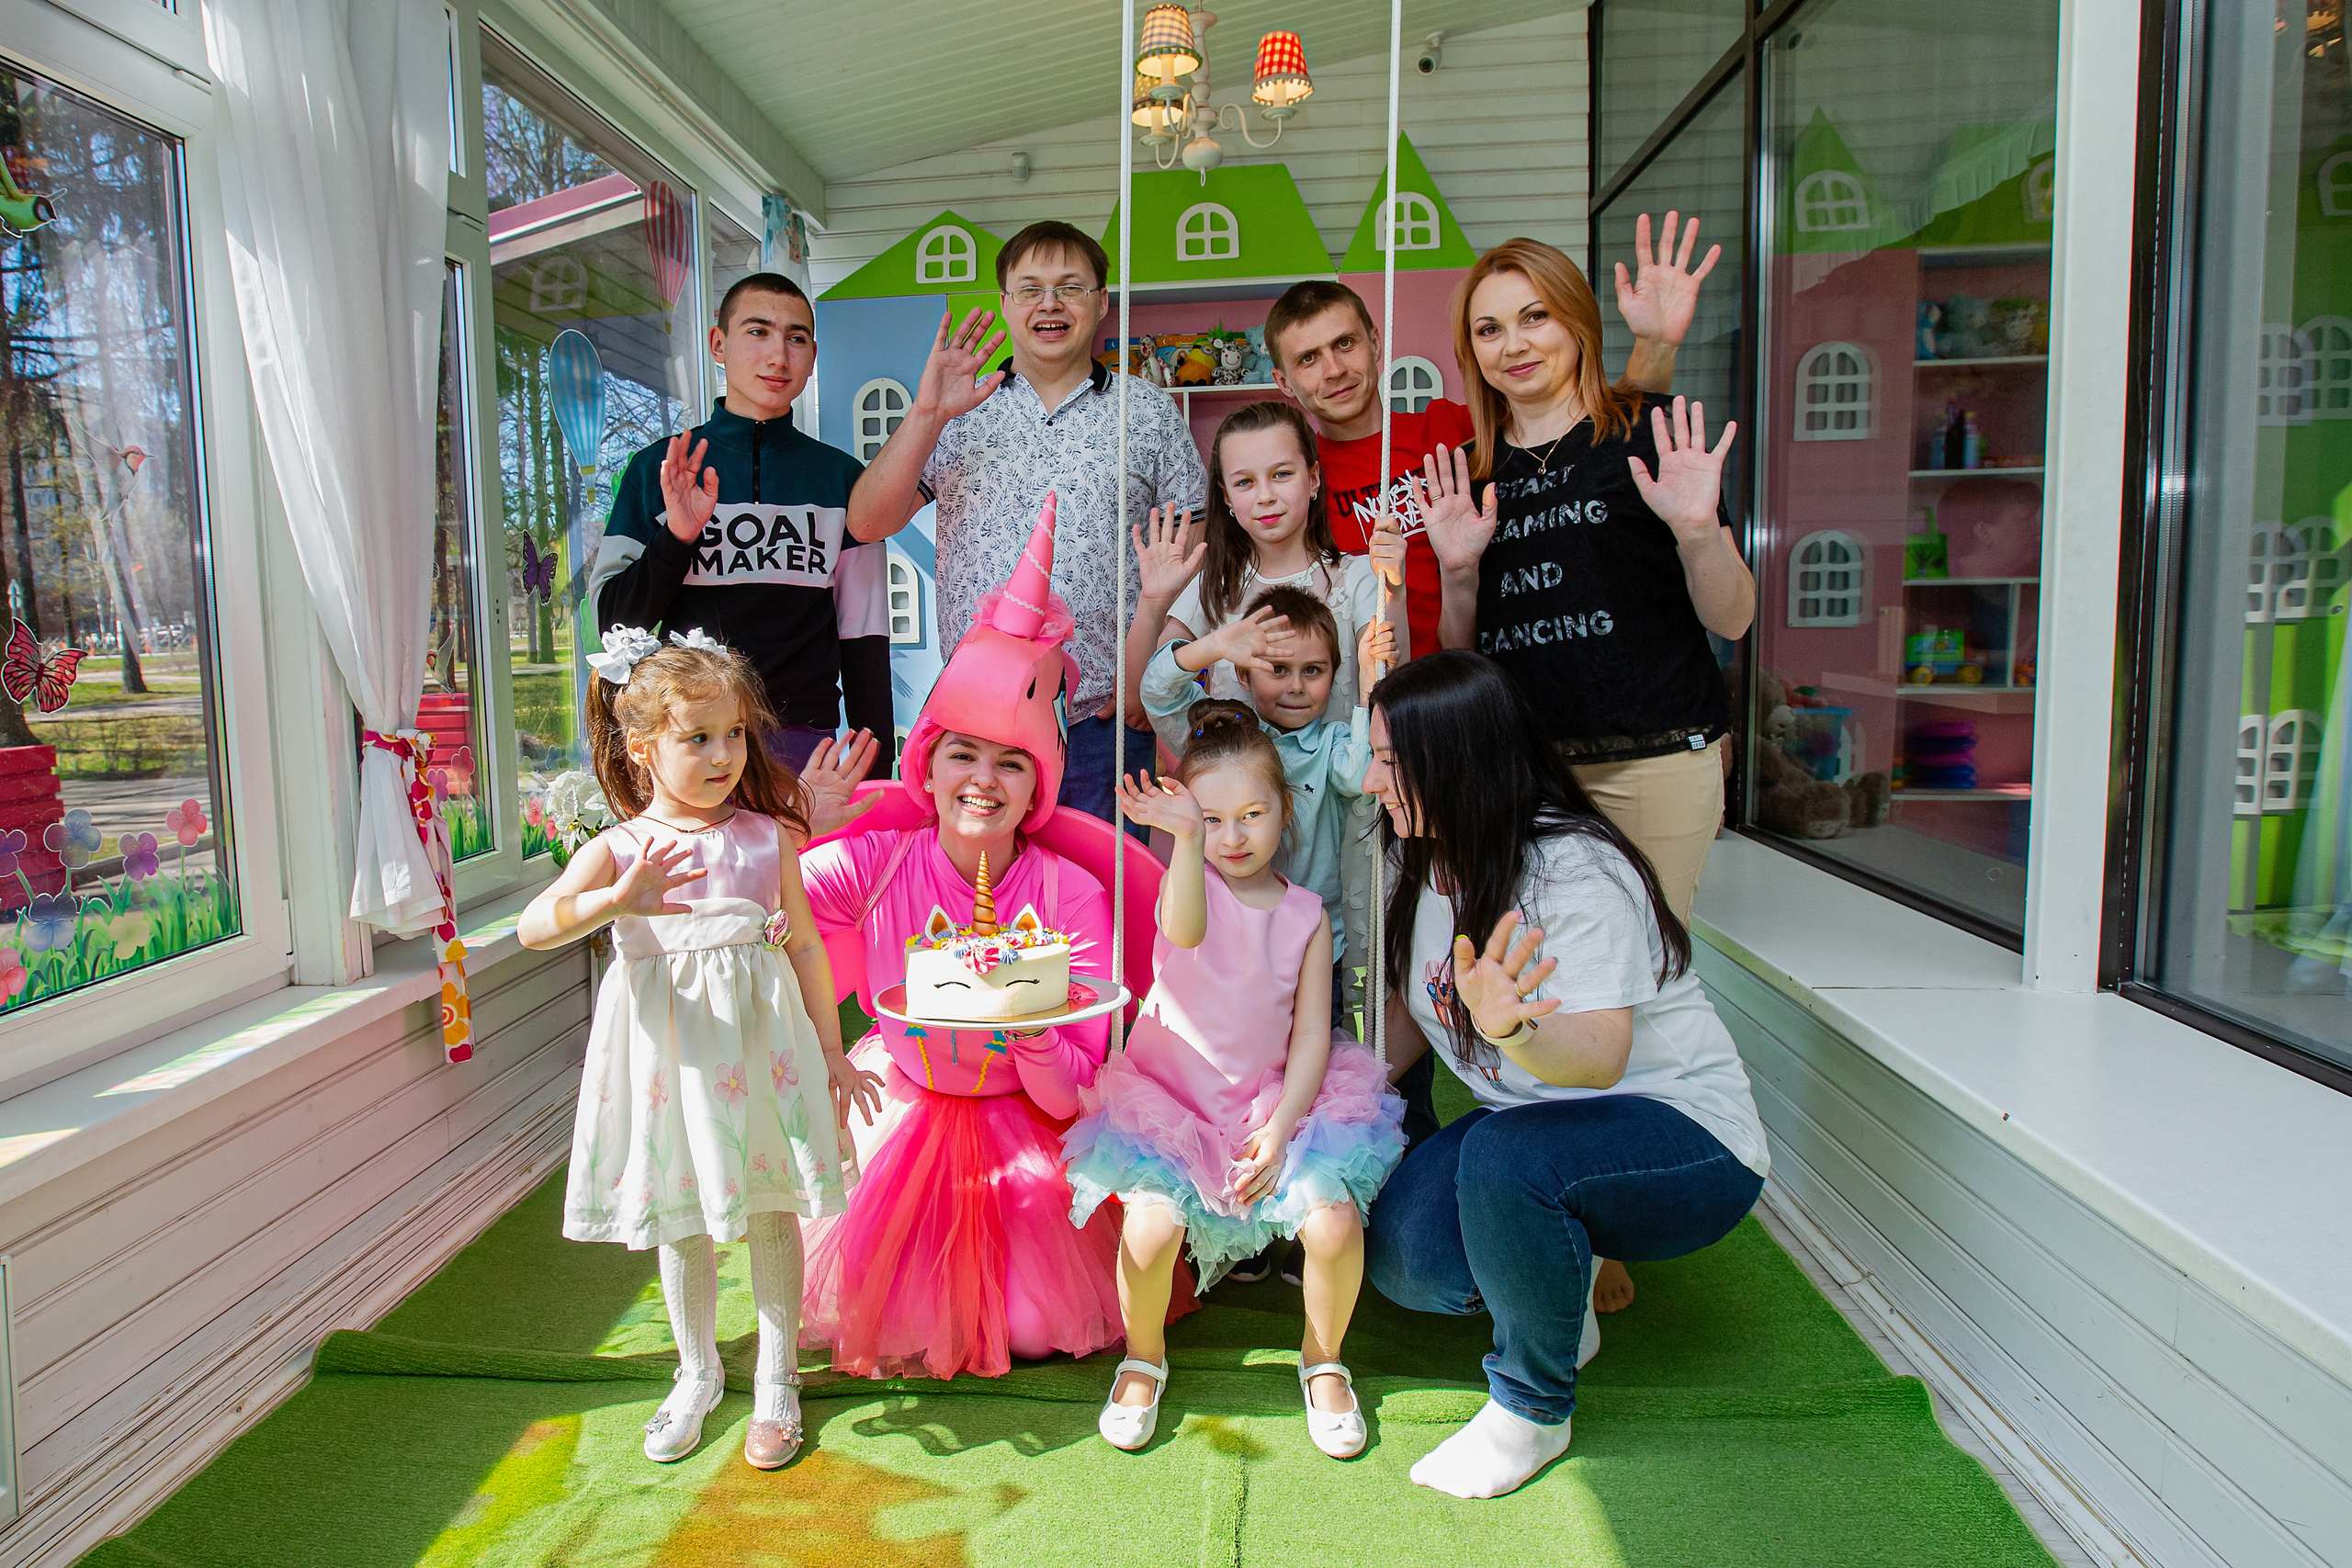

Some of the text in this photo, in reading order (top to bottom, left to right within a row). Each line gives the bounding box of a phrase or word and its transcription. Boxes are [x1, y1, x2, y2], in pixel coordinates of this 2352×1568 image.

[1495, 464, 1576, 500] START
[699, 512, 826, 549] GOAL
[691, 545, 829, 576] MAKER
[1500, 561, 1563, 597] AND
[1480, 610, 1614, 655] DANCING
